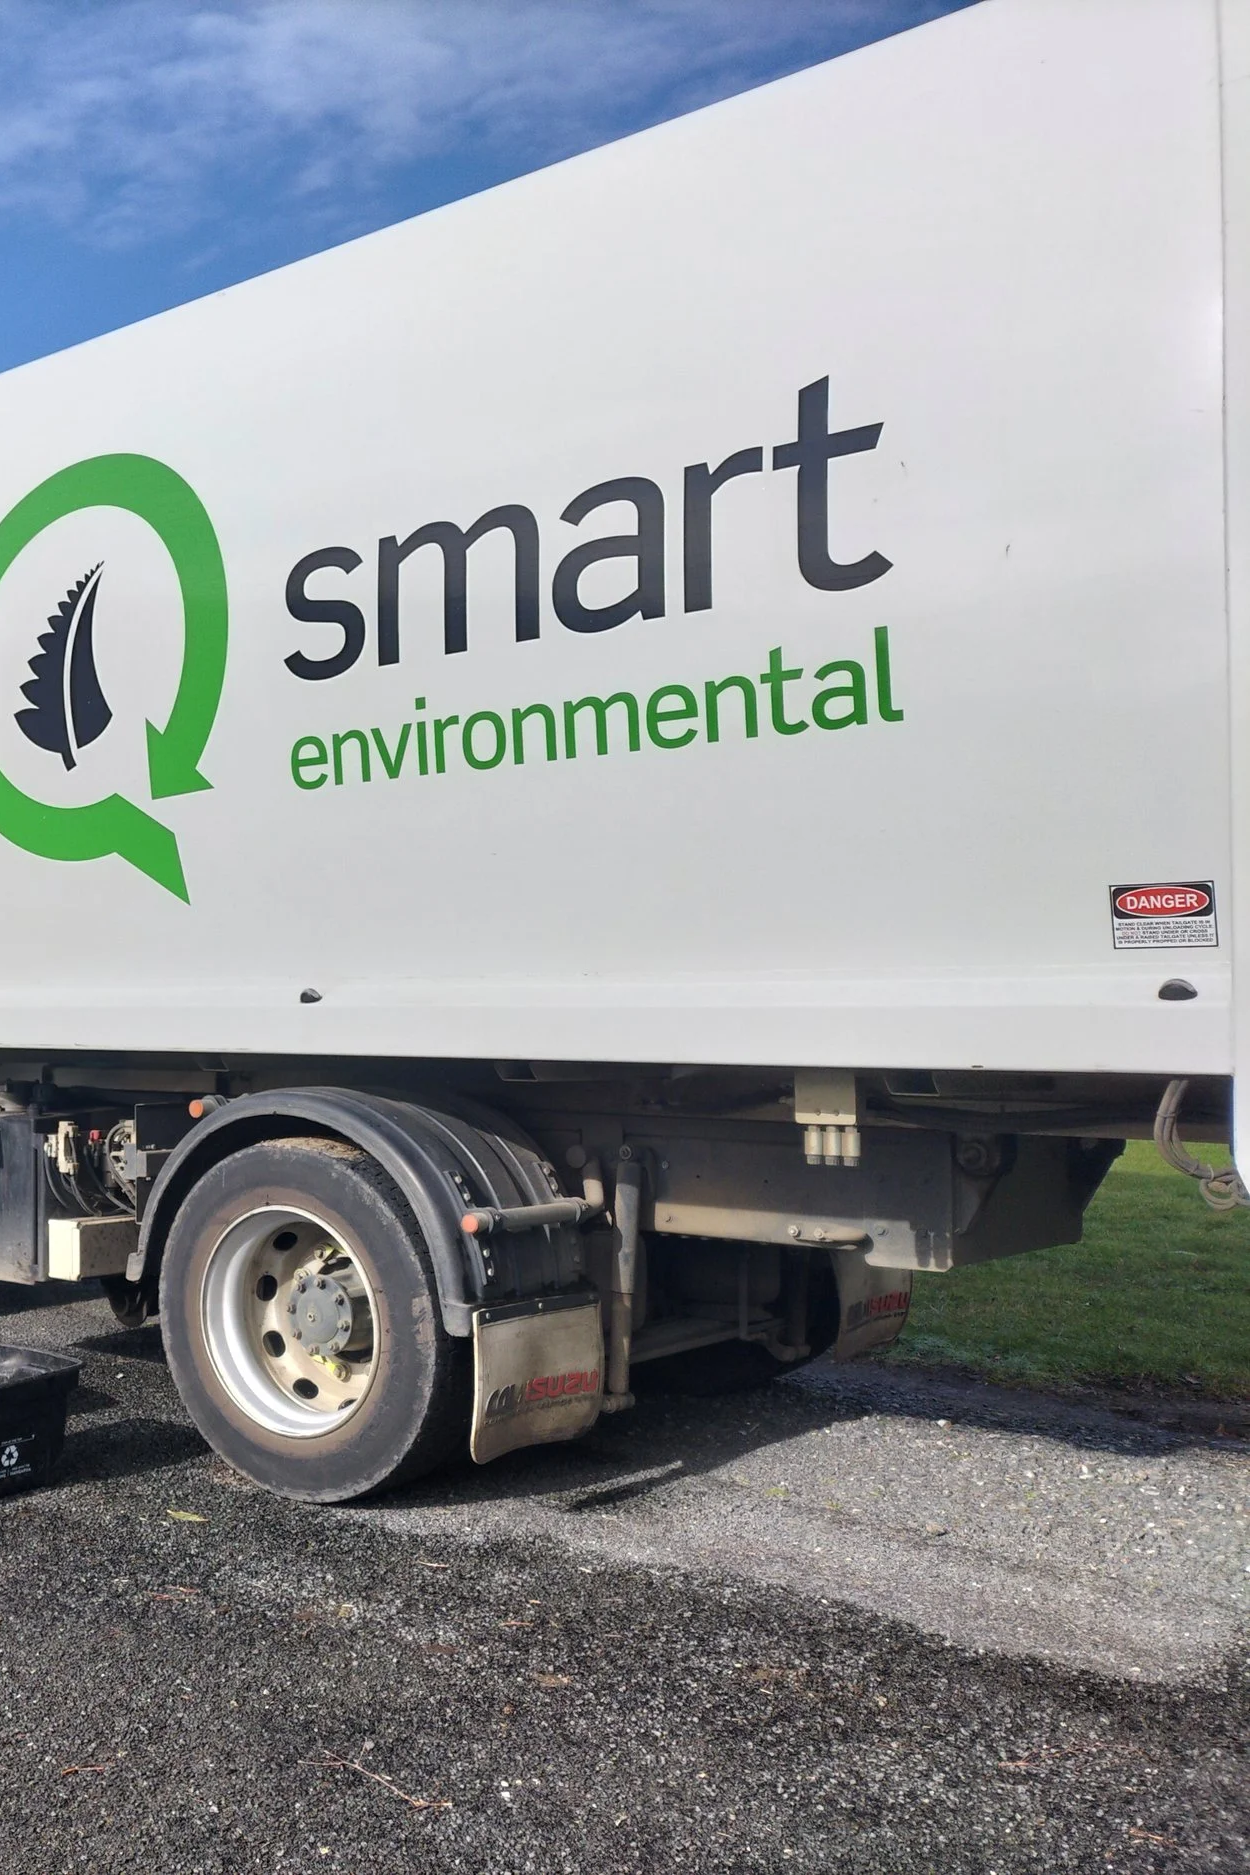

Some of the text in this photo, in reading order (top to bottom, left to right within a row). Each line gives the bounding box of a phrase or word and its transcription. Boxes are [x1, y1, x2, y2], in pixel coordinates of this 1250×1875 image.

[283, 375, 894, 681] smart
[290, 627, 903, 790] environmental
[1126, 894, 1198, 909] DANGER
[525, 1368, 599, 1400] ISUZU
